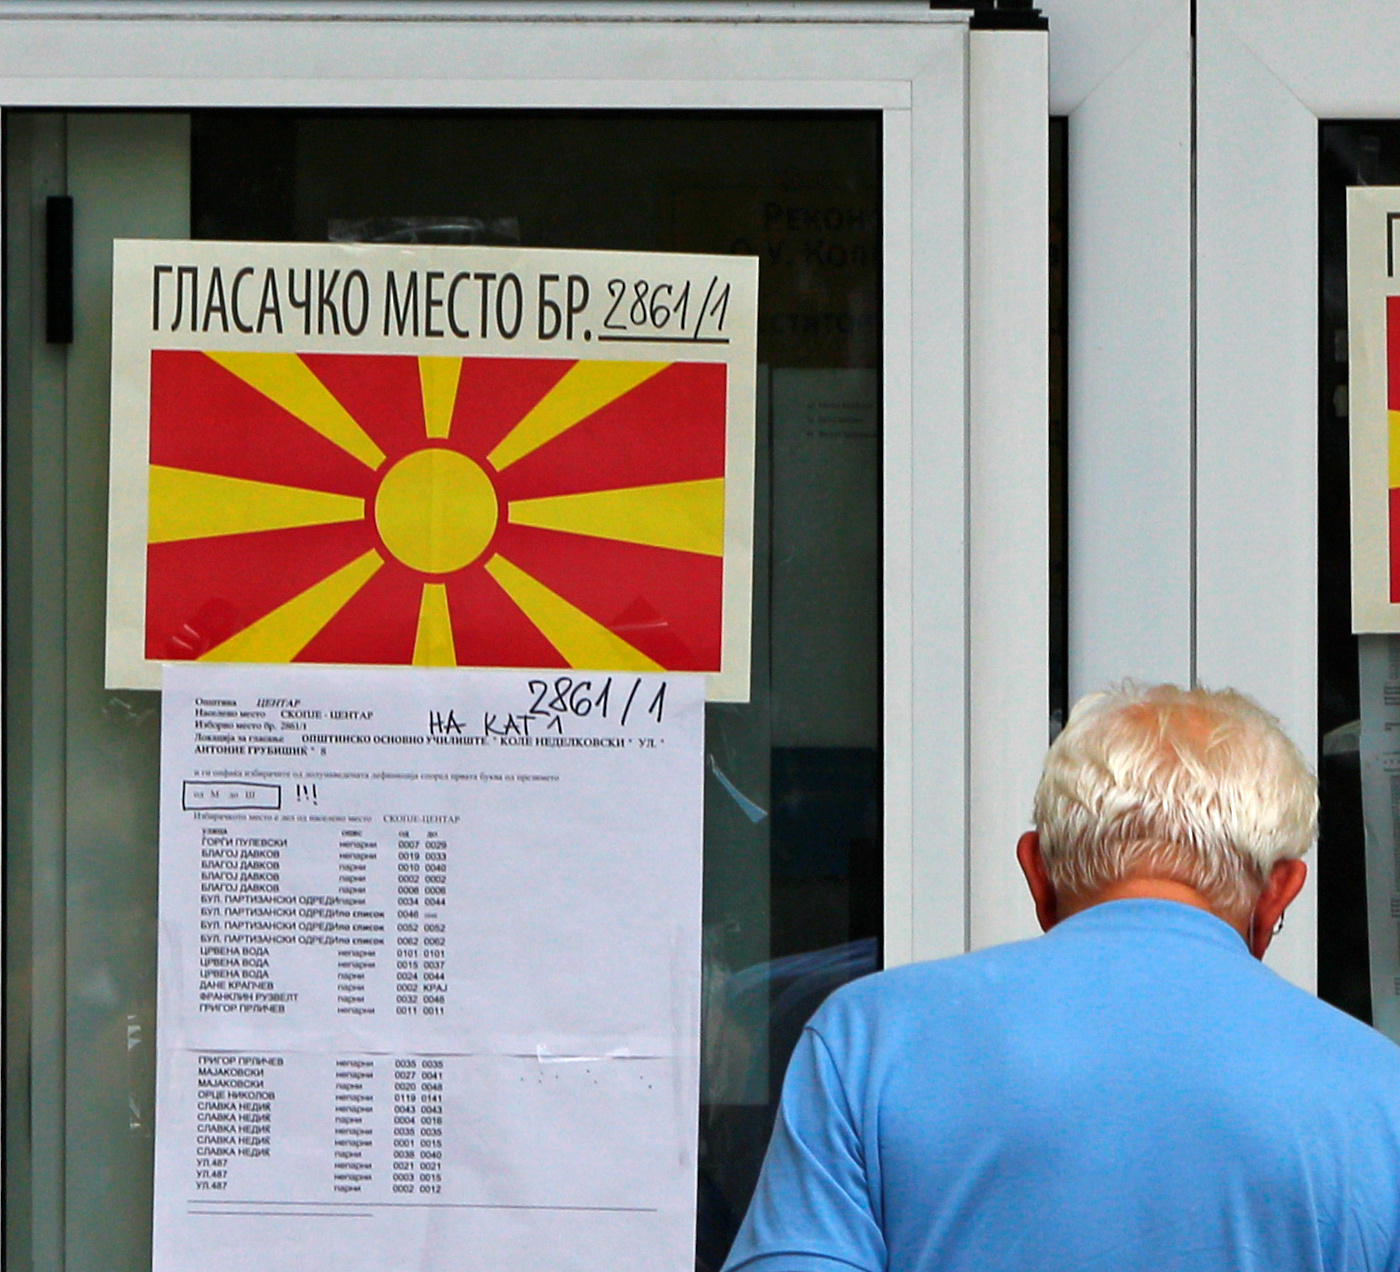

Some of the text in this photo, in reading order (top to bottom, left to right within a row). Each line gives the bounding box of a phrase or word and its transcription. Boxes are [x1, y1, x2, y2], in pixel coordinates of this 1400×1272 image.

[153, 266, 369, 336] ГЛАСАЧКО
[384, 271, 522, 339] МЕСТО
[539, 274, 591, 341] БР.
[604, 276, 730, 333] 2861/1
[256, 698, 301, 708] ЦЕНТАР
[330, 711, 373, 720] ЦЕНТАР
[281, 721, 306, 730] 2861/1
[430, 710, 465, 735] НА
[484, 711, 537, 737] КАТ
[302, 734, 371, 744] ОПШТИНСКО
[373, 735, 424, 744] ОСНОВНО
[500, 735, 532, 746] КОЛЕ
[536, 737, 624, 748] НЕДЕЛКОВСКИ
[195, 745, 245, 754] АНТОНИЕ
[202, 848, 238, 859] БЛАГОЈ
[240, 849, 280, 860] ДАВКОВ
[200, 946, 240, 957] ЦРВЕНА
[242, 946, 269, 957] ВОДА
[198, 1090, 225, 1101] ОРЦЕ
[228, 1090, 275, 1101] НИКОЛОВ
[196, 1181, 227, 1190] УЛ.487
